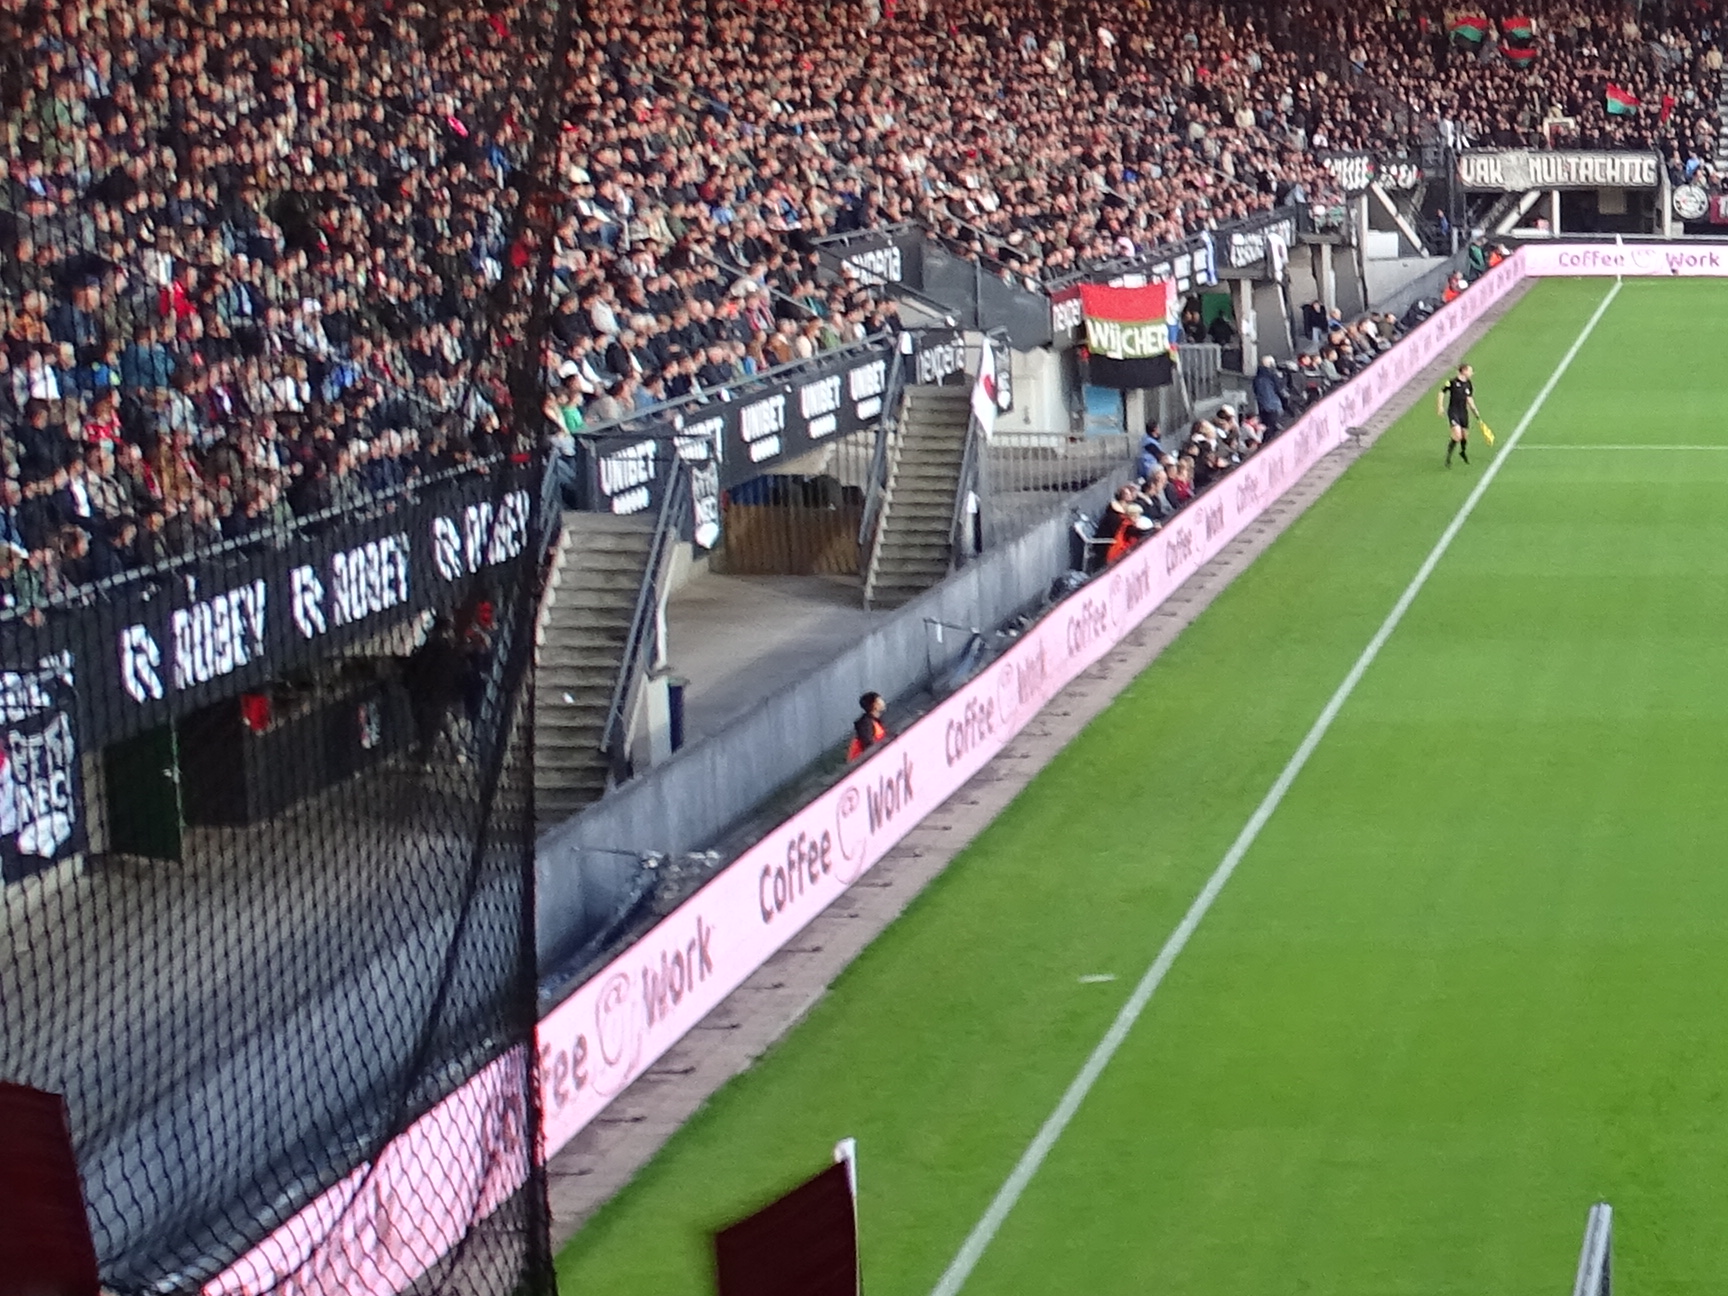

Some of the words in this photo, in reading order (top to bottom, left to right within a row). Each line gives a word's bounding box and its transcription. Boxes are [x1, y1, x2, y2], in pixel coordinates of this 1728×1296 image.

[1461, 157, 1505, 186] VAK
[1529, 156, 1657, 185] NULTACHTIG
[1558, 248, 1625, 269] Coffee
[1665, 251, 1720, 270] Work
[1165, 529, 1194, 572] Coffee
[1204, 503, 1225, 539] Work
[1066, 599, 1108, 654] Coffee
[1124, 557, 1151, 610] Work
[944, 688, 995, 768] Coffee
[1016, 641, 1047, 704] Work
[758, 824, 834, 925] Coffee
[866, 750, 915, 836] Work
[642, 915, 714, 1029] Work
